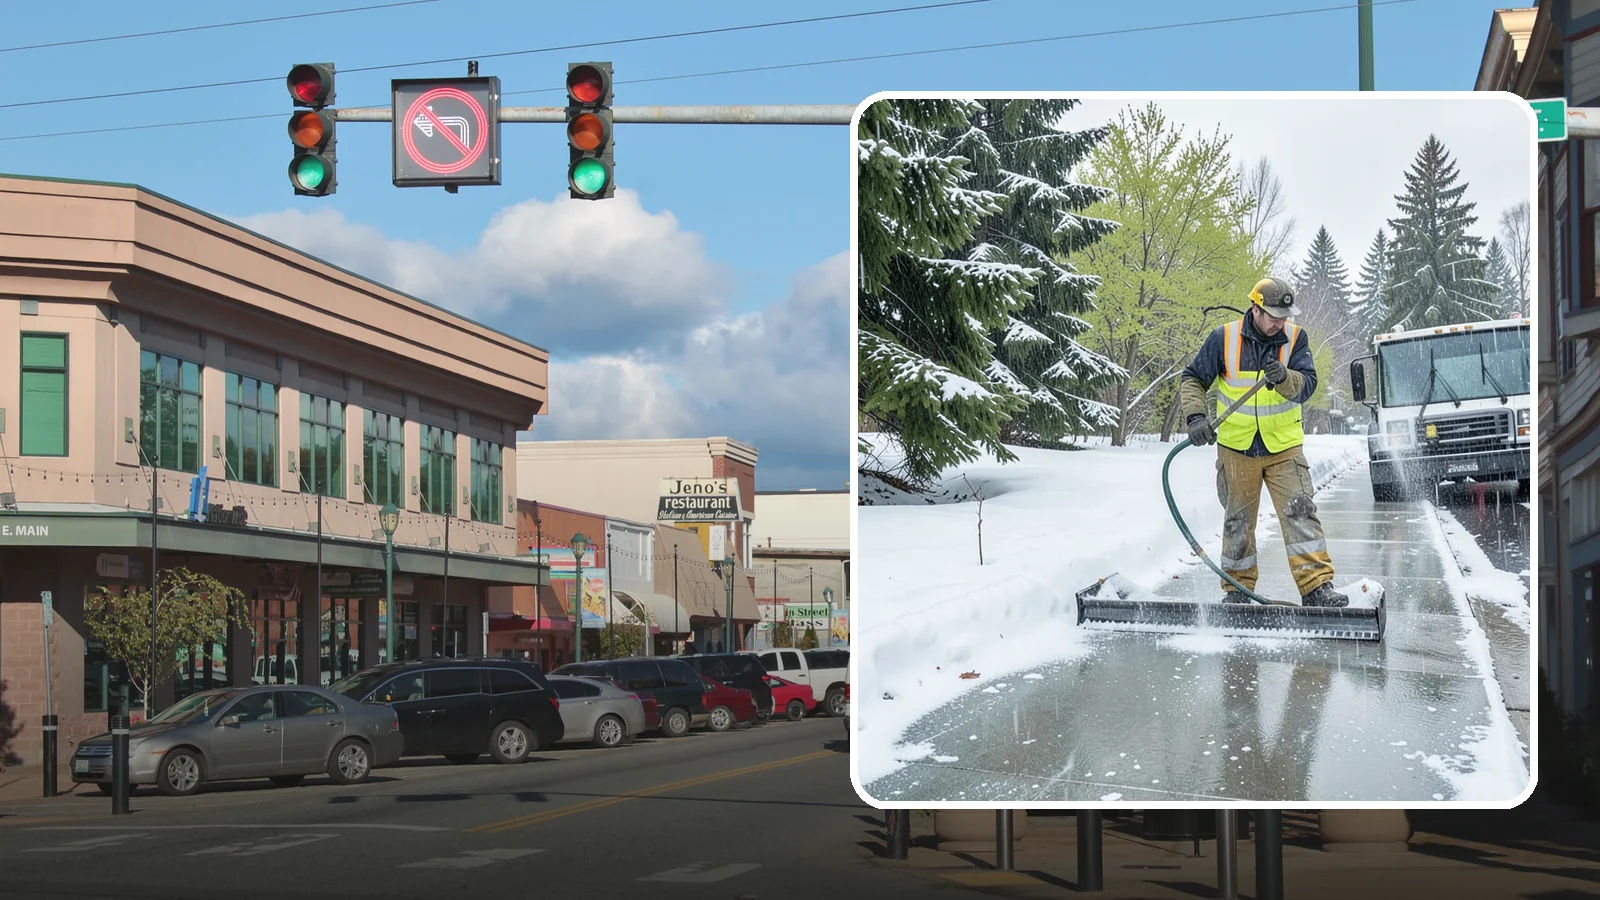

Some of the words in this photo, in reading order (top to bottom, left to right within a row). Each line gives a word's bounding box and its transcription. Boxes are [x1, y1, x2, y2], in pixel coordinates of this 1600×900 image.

[670, 480, 727, 494] Jeno's
[665, 496, 731, 509] restaurant
[686, 509, 714, 519] American
[715, 509, 737, 519] Cuisine
[2, 525, 13, 536] E.
[15, 525, 49, 536] MAIN
[797, 607, 829, 616] Street
